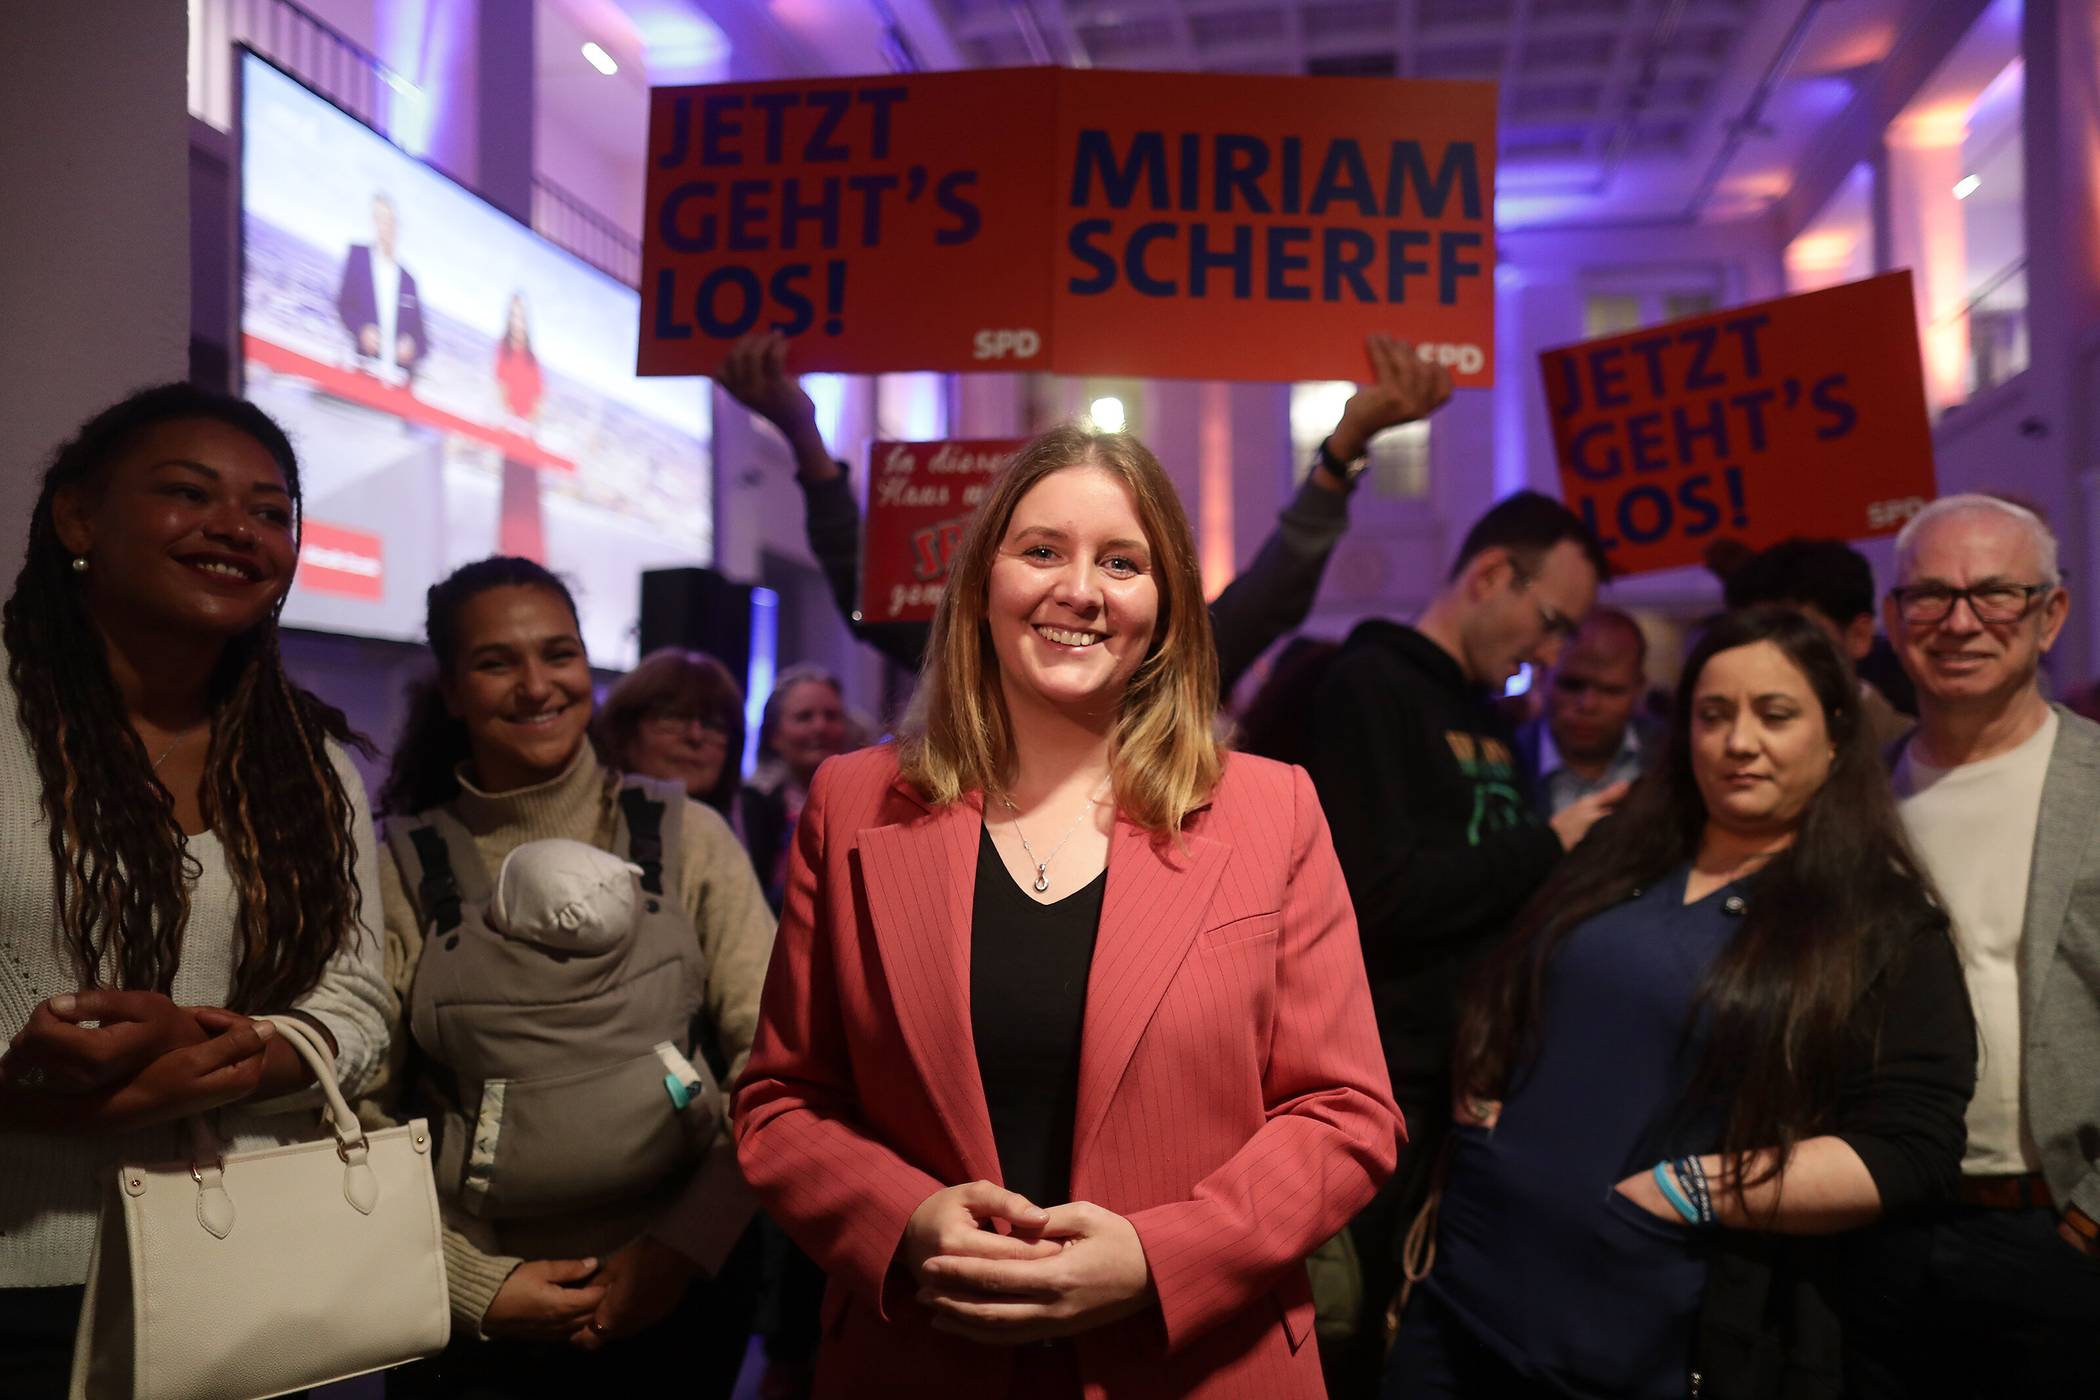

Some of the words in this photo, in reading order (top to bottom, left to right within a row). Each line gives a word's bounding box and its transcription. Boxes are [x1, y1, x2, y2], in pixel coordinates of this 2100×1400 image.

[657, 86, 908, 169] JETZT
[657, 165, 981, 254] GEHT’S
[1068, 128, 1484, 221] MIRIAM
[654, 258, 848, 340] LOS!
[1067, 217, 1484, 305] SCHERFF
[972, 328, 1041, 360] SPD
[1557, 313, 1770, 419] JETZT
[1570, 371, 1858, 482] GEHT’S
[1579, 466, 1749, 550] LOS!
